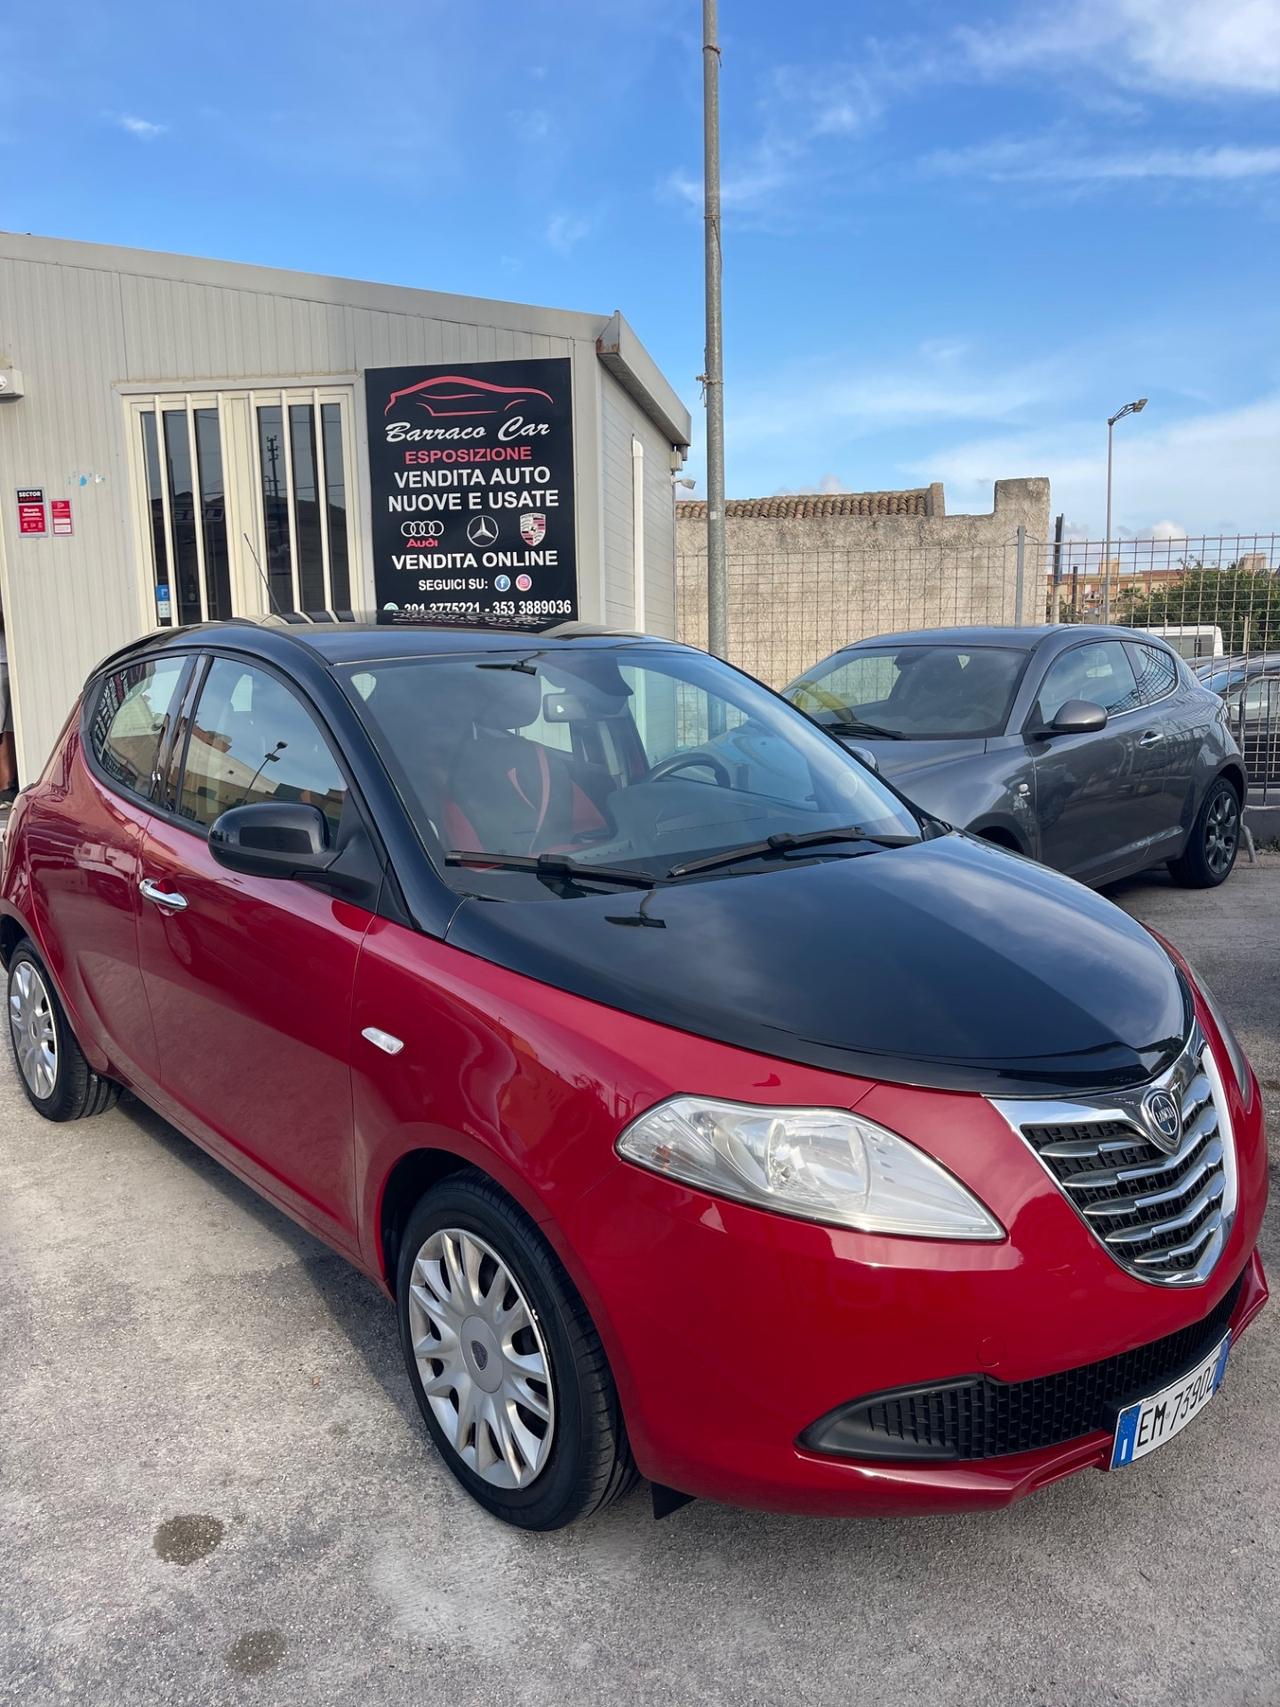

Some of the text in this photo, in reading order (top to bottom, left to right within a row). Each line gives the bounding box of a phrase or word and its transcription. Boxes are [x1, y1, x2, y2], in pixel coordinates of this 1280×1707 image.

[385, 416, 550, 442] Barraco Car
[405, 446, 532, 465] ESPOSIZIONE
[394, 466, 551, 489] VENDITA AUTO
[388, 490, 559, 512] NUOVE E USATE
[406, 538, 439, 548] Audi
[391, 550, 559, 570] VENDITA ONLINE
[418, 578, 489, 591] SEGUICI SU:
[492, 601, 516, 615] 353
[518, 600, 572, 614] 3889036
[1137, 1401, 1168, 1447] EM
